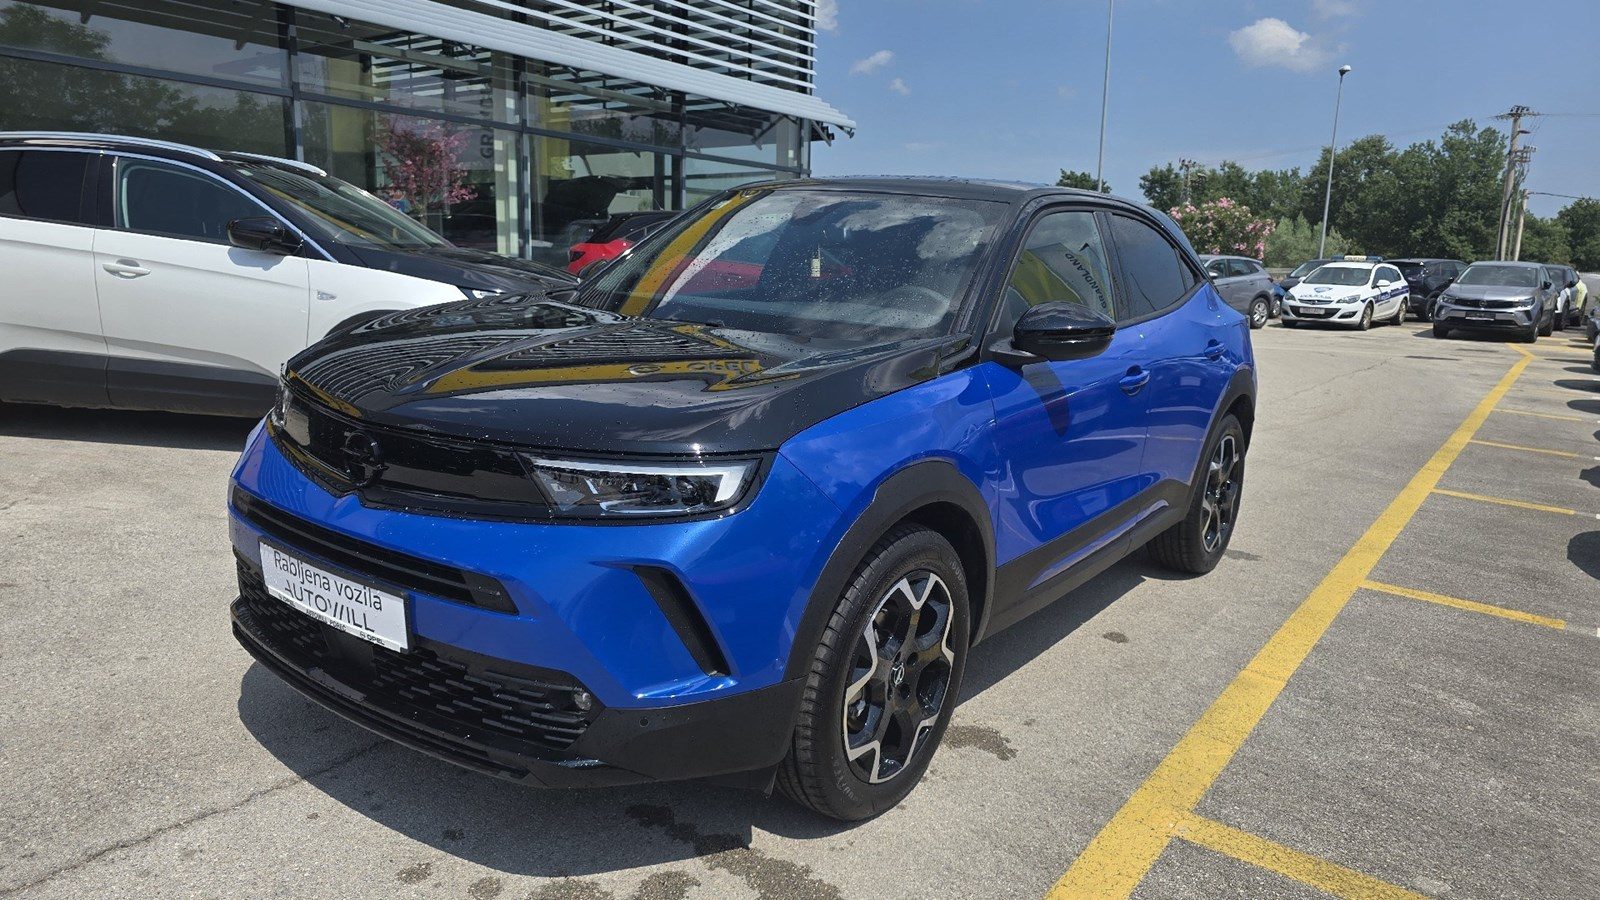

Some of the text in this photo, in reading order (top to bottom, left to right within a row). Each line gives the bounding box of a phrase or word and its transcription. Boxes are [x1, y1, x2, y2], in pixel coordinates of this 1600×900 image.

[1065, 253, 1106, 308] GRANDLAND
[274, 550, 382, 611] Rabljena vozila
[367, 634, 385, 645] OPEL
